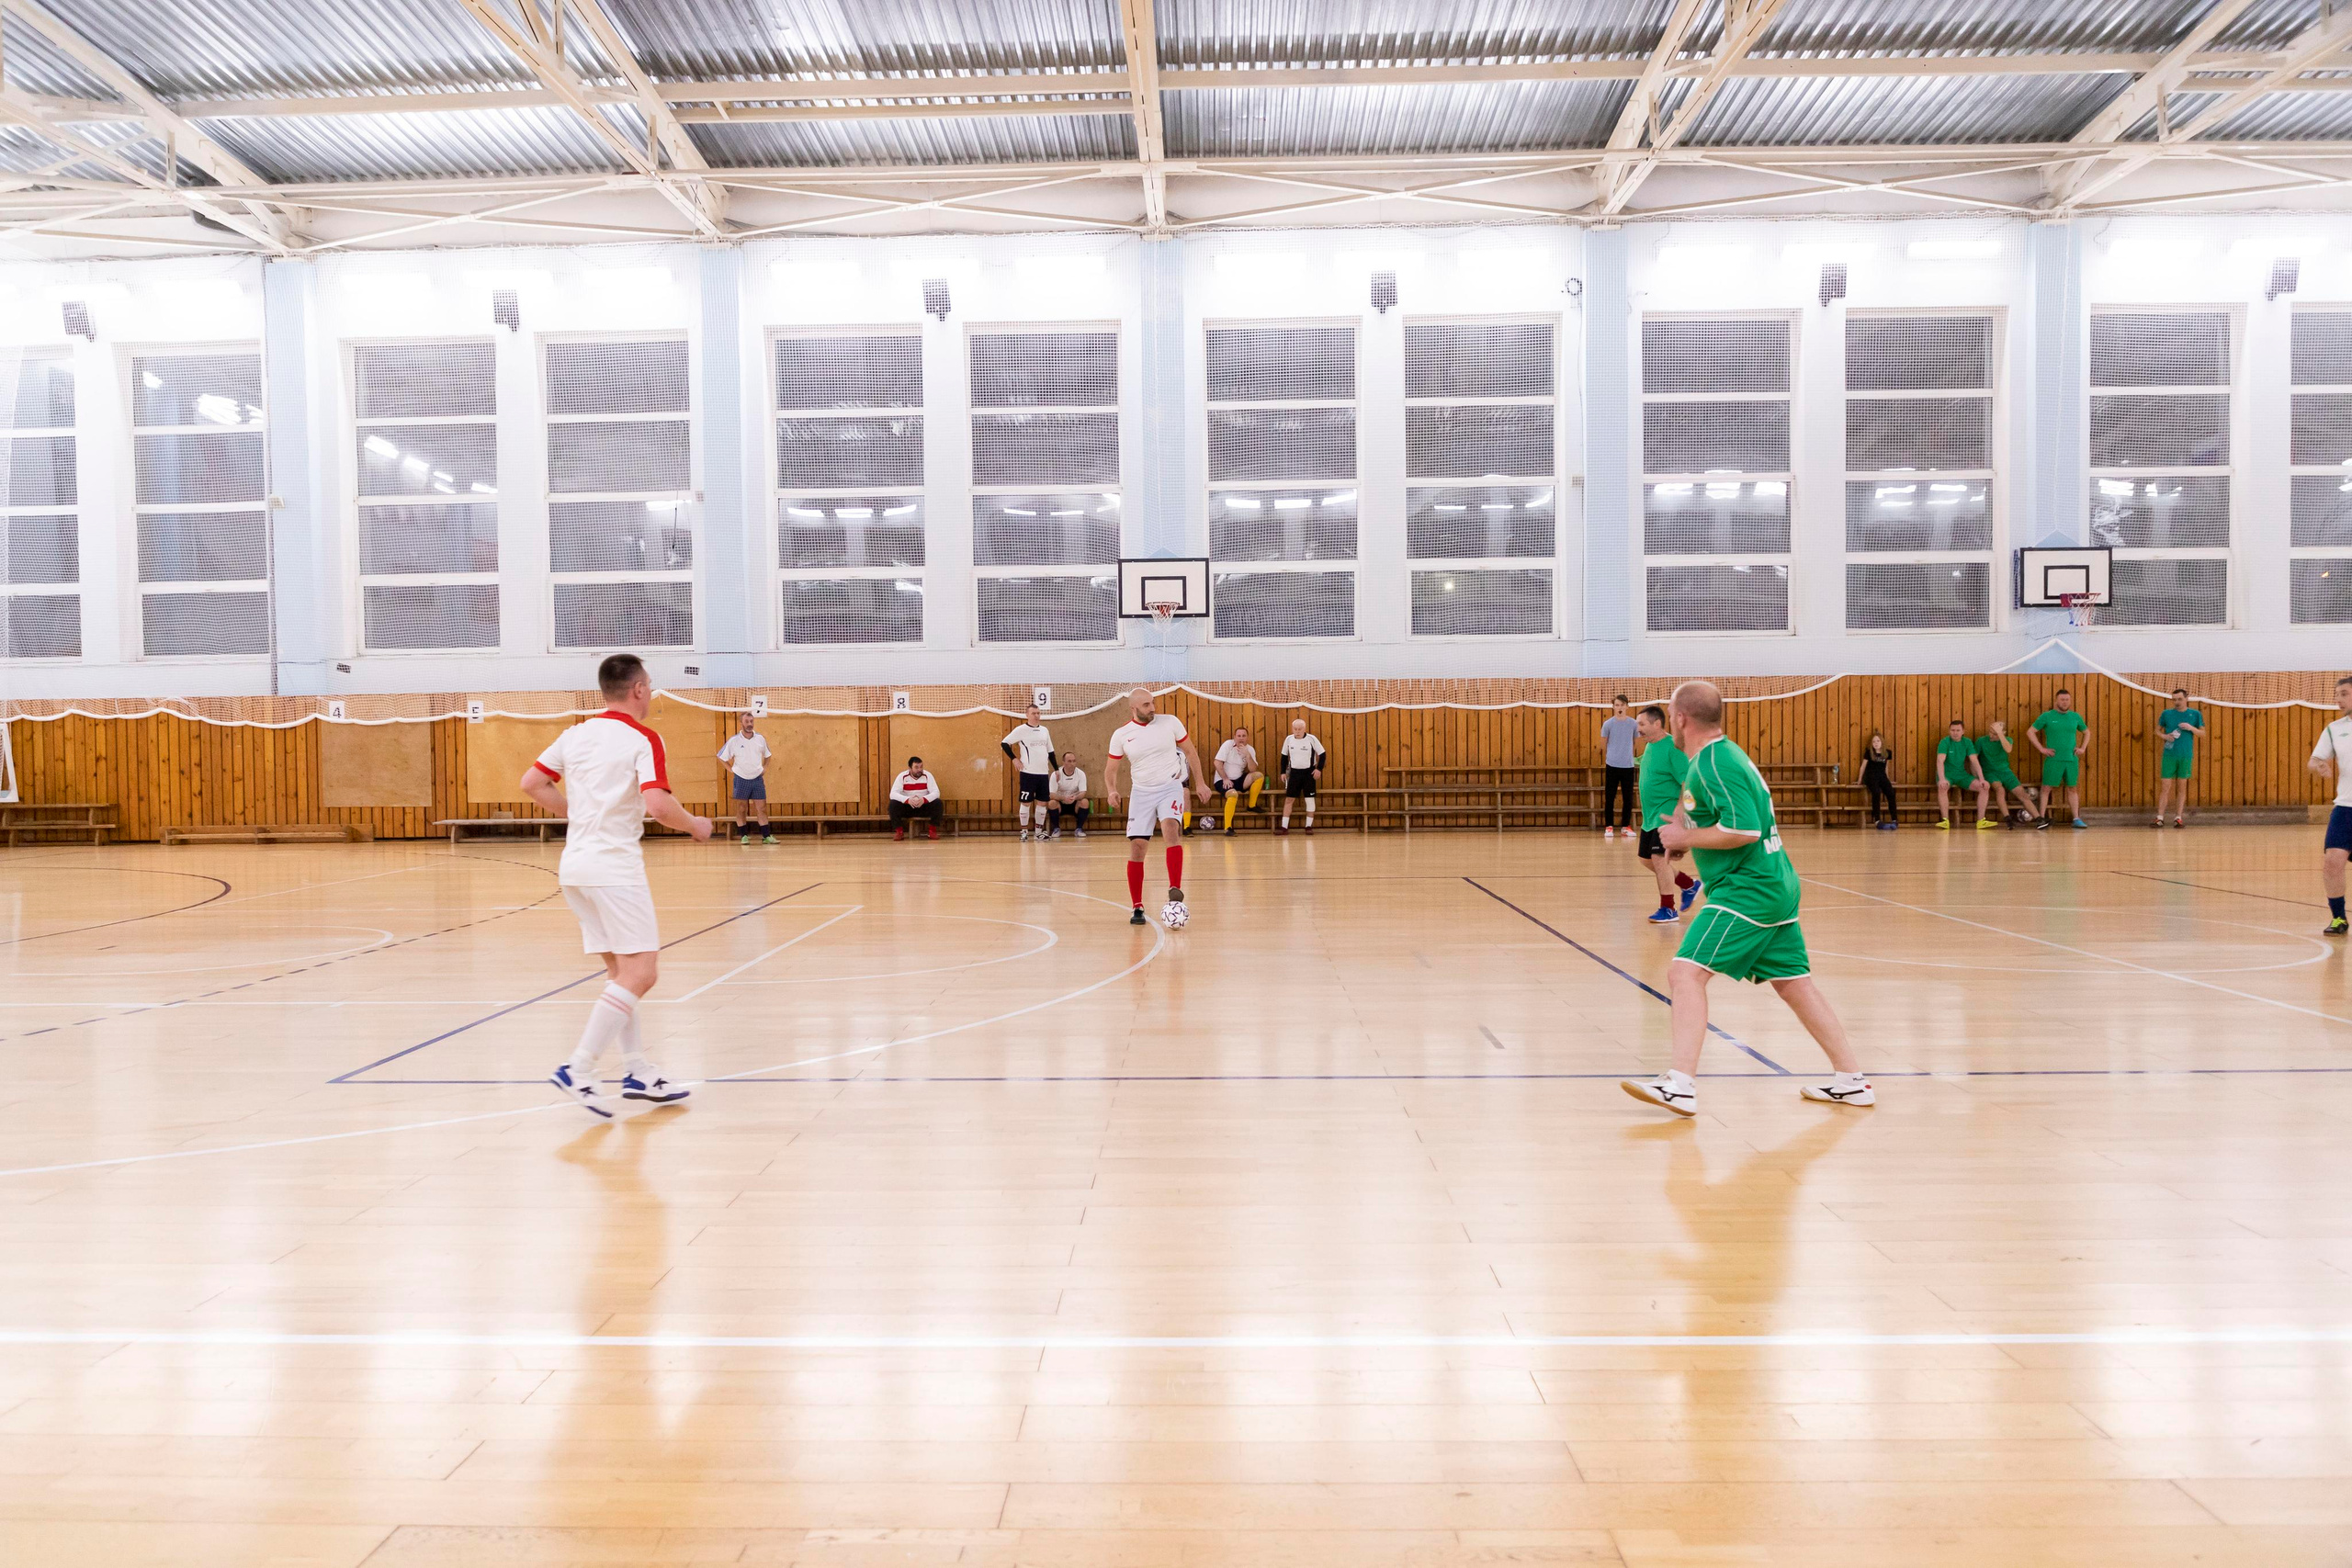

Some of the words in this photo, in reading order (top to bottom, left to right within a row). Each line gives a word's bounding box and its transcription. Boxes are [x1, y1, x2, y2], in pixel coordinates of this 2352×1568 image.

[897, 697, 906, 709] 8
[1038, 693, 1046, 705] 9
[333, 706, 342, 718] 4
[471, 706, 480, 719] 5
[755, 701, 764, 714] 7
[1021, 791, 1030, 800] 77
[1170, 800, 1183, 814] 46
